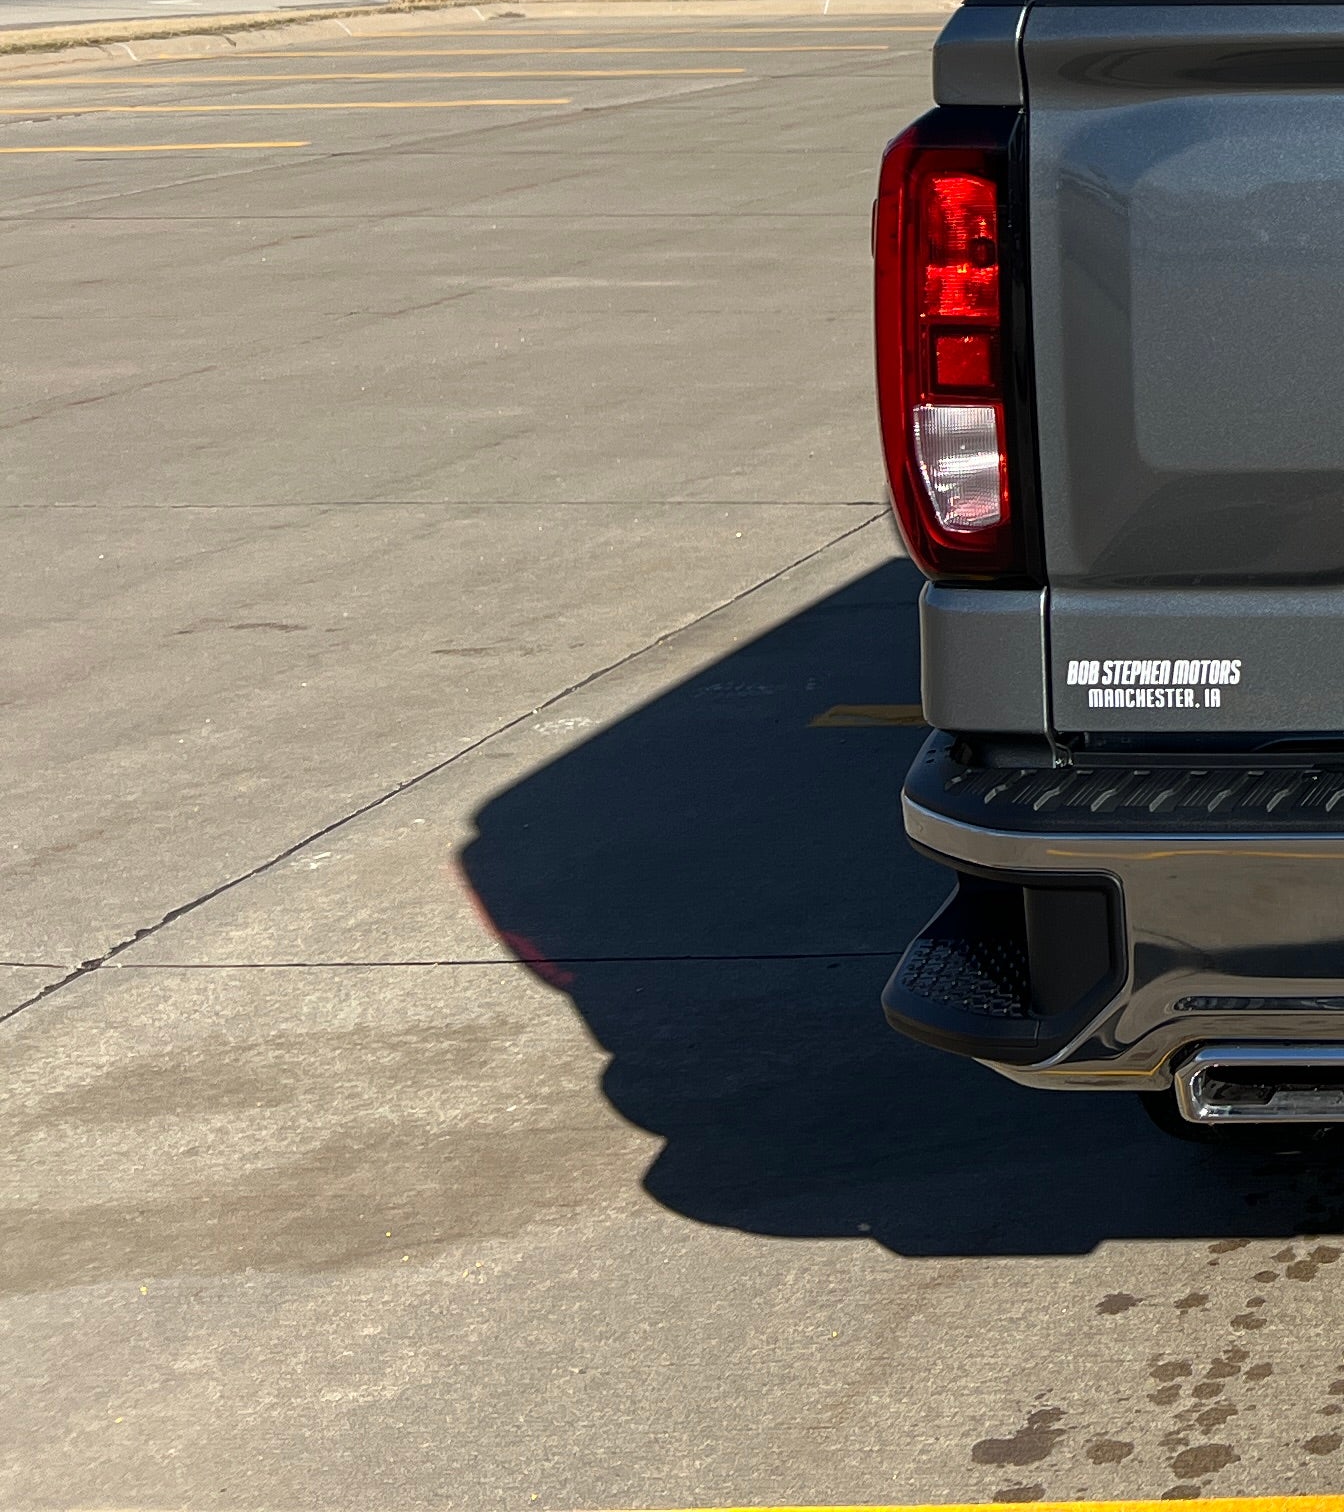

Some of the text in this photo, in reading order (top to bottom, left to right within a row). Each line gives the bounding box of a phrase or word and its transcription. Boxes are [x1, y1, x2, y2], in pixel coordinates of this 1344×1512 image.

[1067, 659, 1242, 685] BOB STEPHEN MOTORS
[1204, 688, 1221, 708] IA
